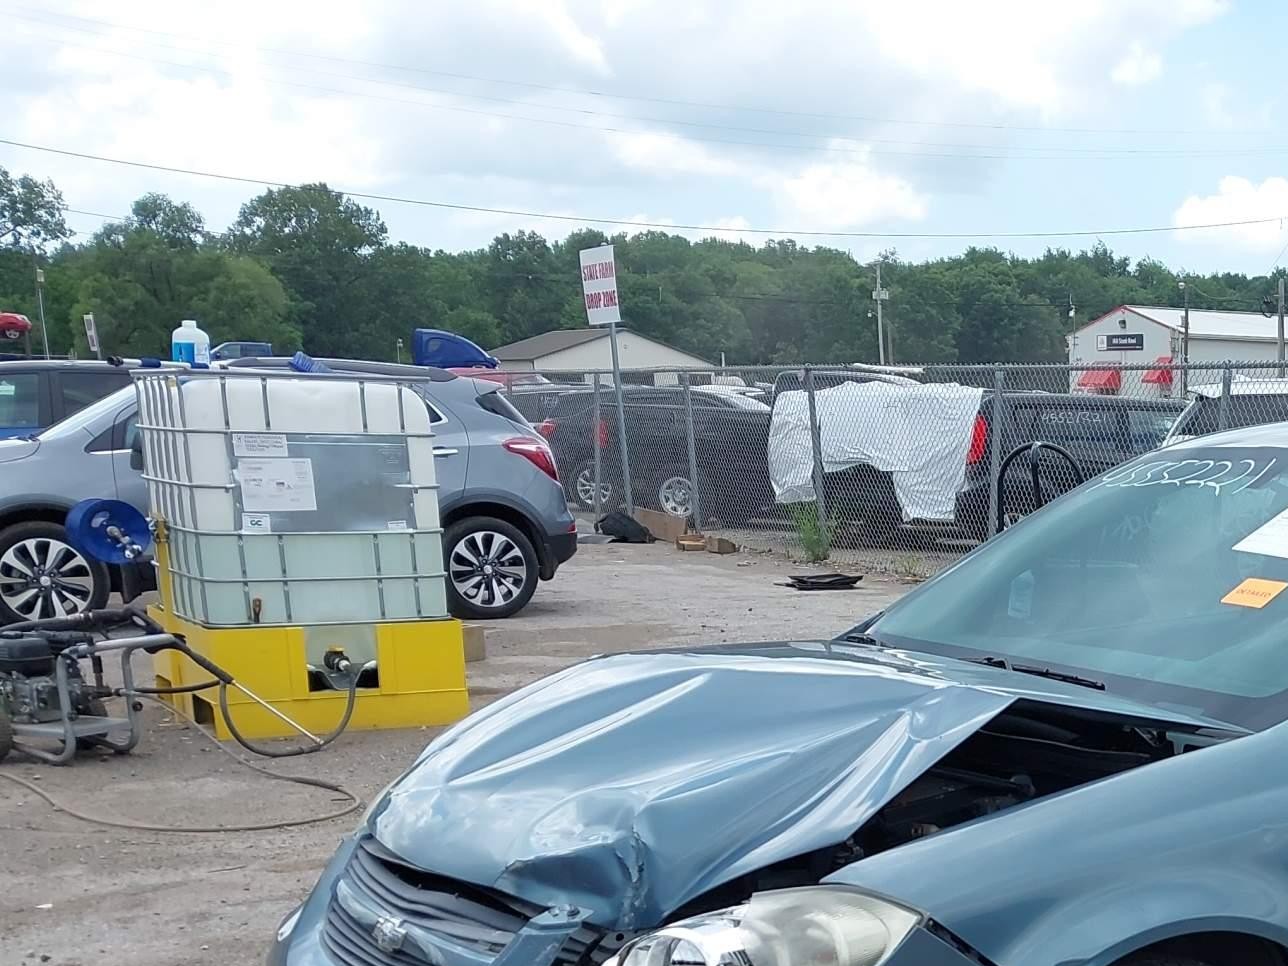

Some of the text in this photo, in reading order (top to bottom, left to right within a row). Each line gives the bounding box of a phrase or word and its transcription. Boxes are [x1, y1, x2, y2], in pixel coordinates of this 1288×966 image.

[583, 264, 598, 281] STATE
[586, 290, 617, 309] DROP ZONE
